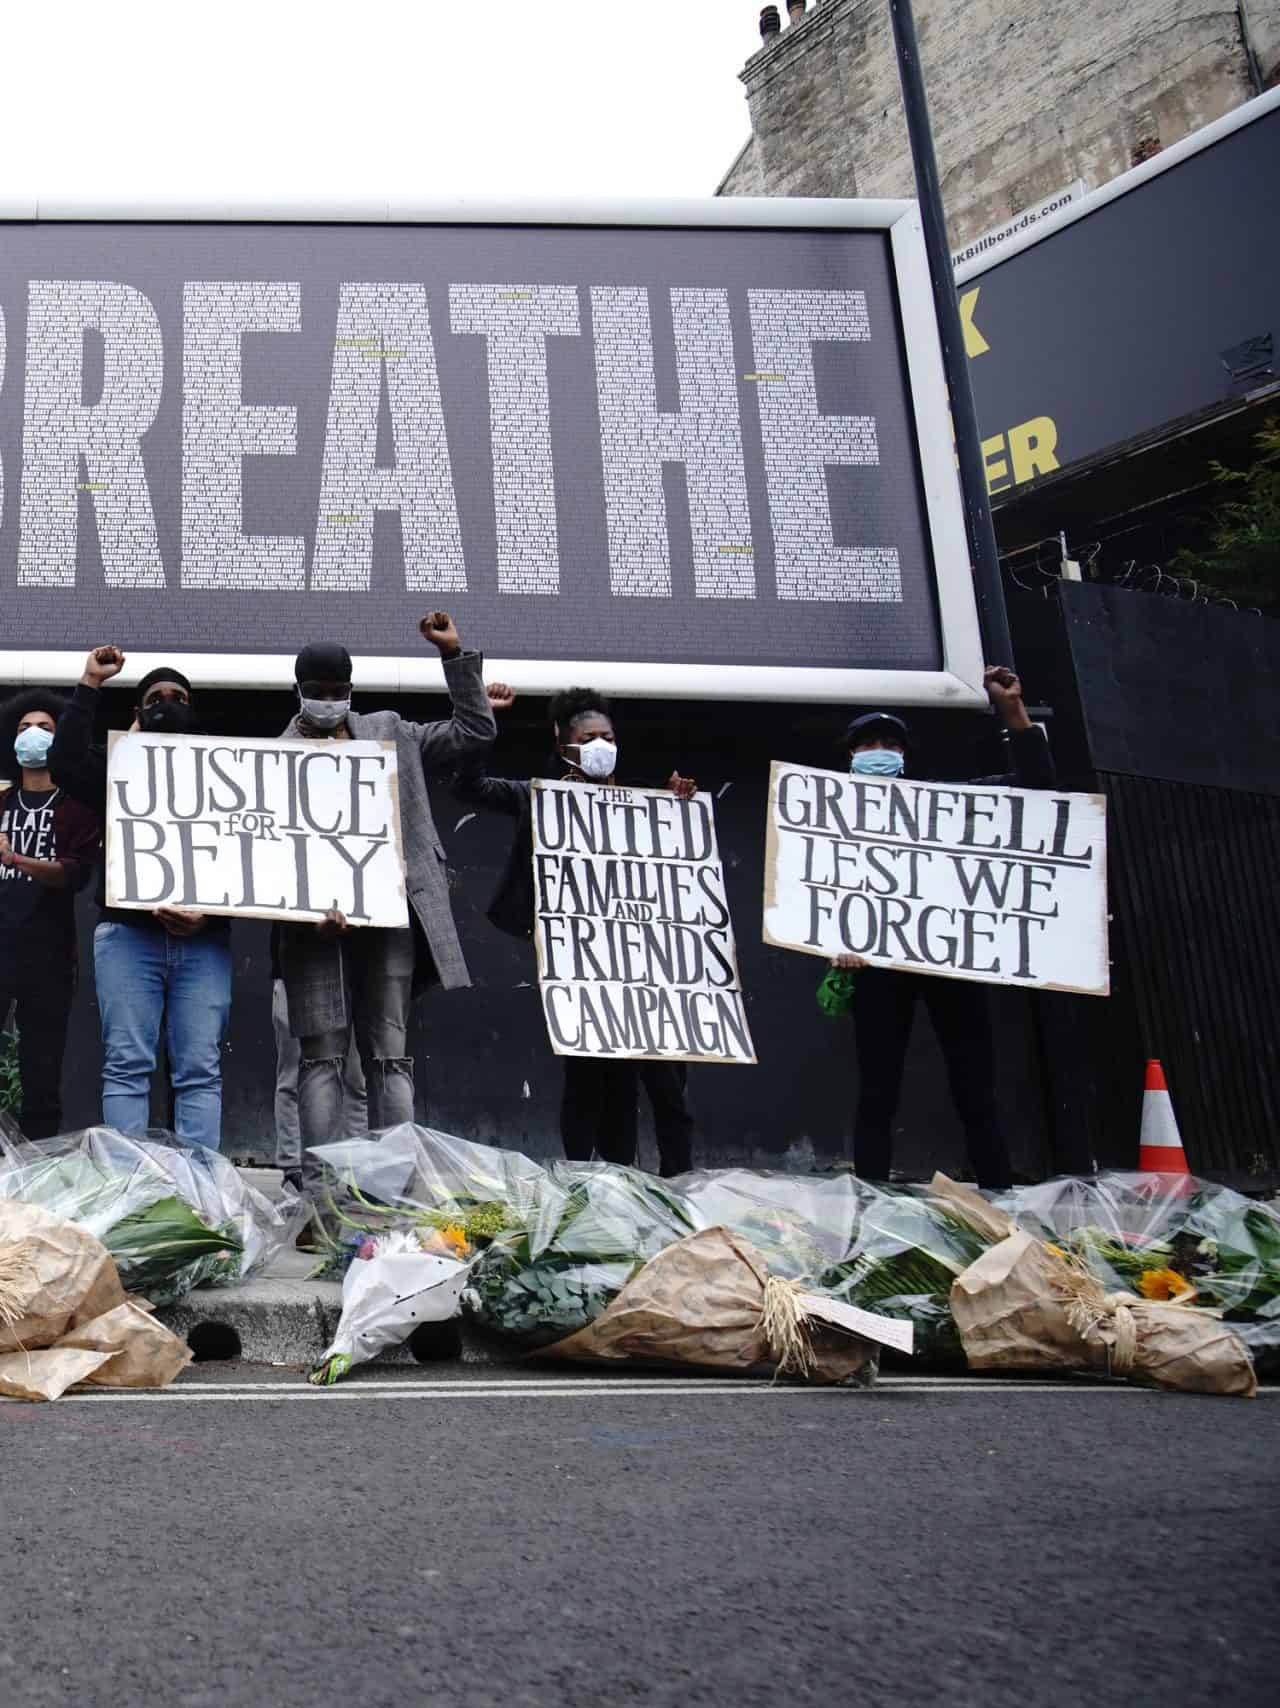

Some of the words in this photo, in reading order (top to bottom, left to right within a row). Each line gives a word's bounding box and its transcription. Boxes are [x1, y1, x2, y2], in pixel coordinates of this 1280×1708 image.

[112, 745, 389, 838] JUSTICE
[535, 787, 714, 862] UNITED
[598, 786, 633, 804] THE
[777, 772, 1093, 861] GRENFELL
[115, 818, 390, 921] BELLY
[535, 854, 730, 930] FAMILIES
[799, 836, 932, 900] LEST
[948, 855, 1059, 919] WE
[614, 900, 654, 922] AND
[803, 886, 1046, 979] FORGET
[538, 915, 736, 988] FRIENDS
[545, 985, 754, 1059] CAMPAIGN
